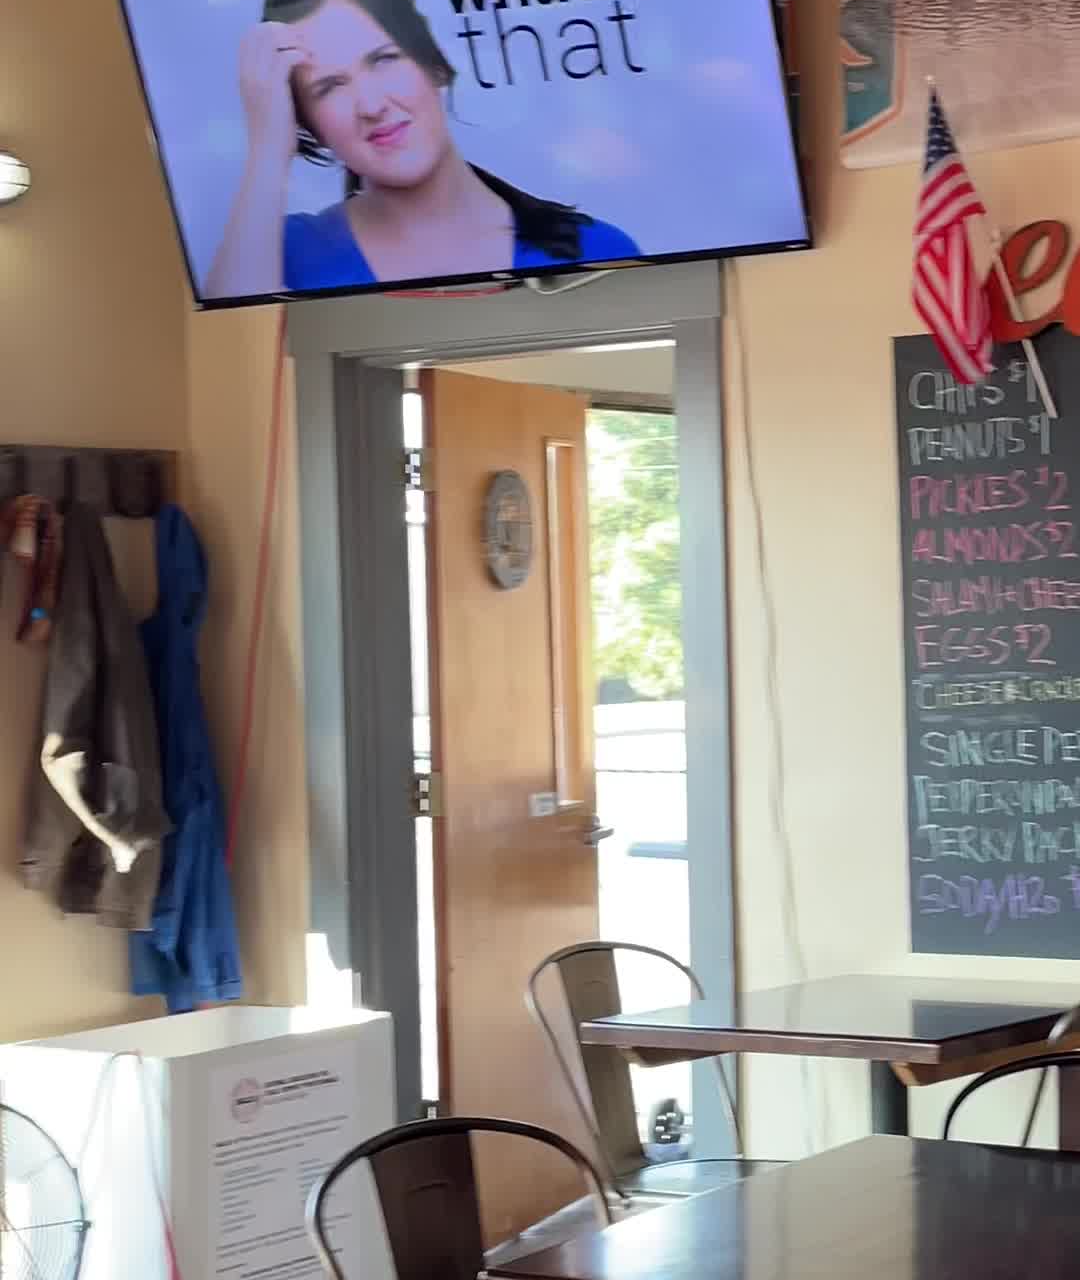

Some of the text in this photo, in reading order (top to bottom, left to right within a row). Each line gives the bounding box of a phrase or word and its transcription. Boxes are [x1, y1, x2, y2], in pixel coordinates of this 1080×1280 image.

[456, 0, 649, 90] that
[907, 417, 1027, 466] PEANUTS
[910, 470, 1030, 521] PICKLES
[911, 523, 1048, 565] ALMONDS
[913, 624, 1011, 669] EGGS
[919, 729, 1040, 768] SINGLE
